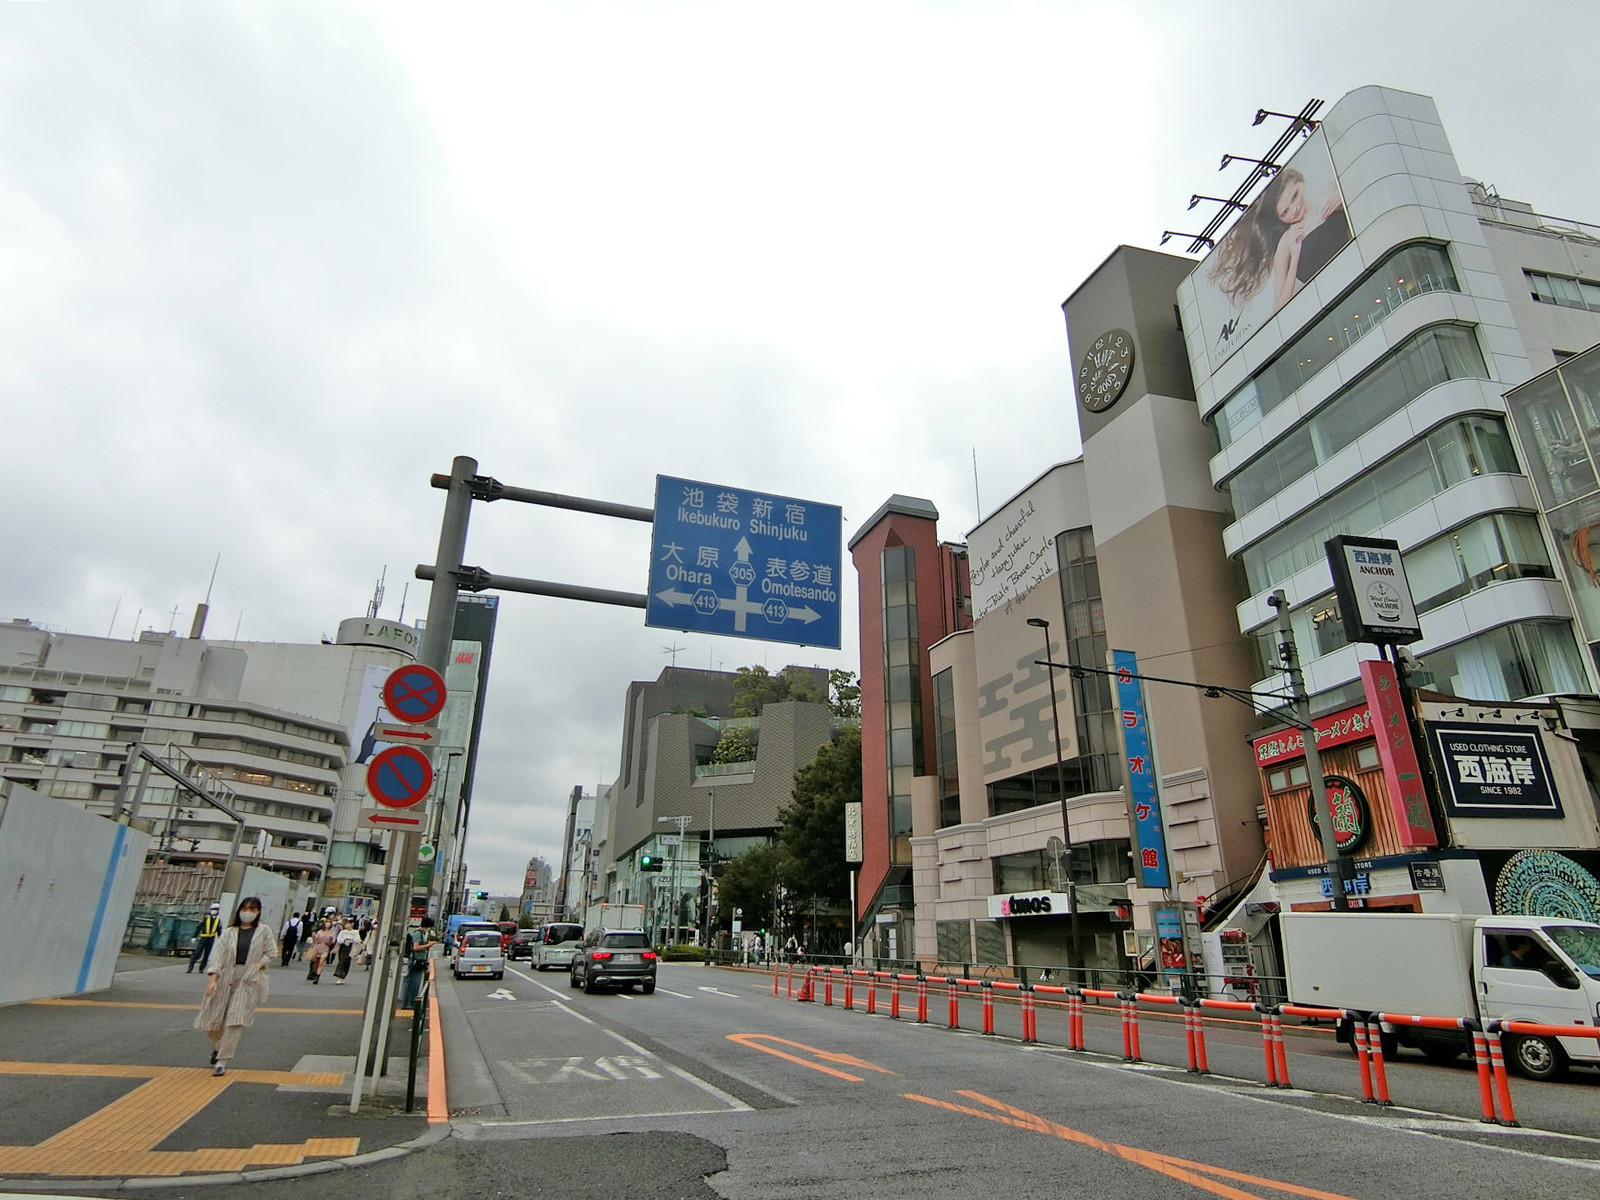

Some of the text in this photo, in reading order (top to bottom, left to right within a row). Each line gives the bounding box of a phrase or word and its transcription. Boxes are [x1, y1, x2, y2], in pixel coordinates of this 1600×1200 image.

[1115, 336, 1123, 347] 2
[1121, 347, 1128, 358] 3
[1120, 364, 1127, 373] 4
[1080, 383, 1087, 392] 9
[1114, 381, 1120, 390] 5
[1085, 393, 1092, 403] 8
[1094, 397, 1100, 407] 7
[1104, 392, 1111, 403] 6
[681, 486, 806, 525] 池袋 新宿
[677, 507, 808, 541] Ikebukuro Shinjuku
[660, 541, 719, 569] 大原
[1029, 537, 1054, 565] Castle
[1352, 550, 1393, 565] 西海岸
[666, 564, 713, 586] Ohara
[732, 566, 753, 582] 305
[765, 557, 833, 586] 表参道
[1360, 566, 1395, 576] ANCHOR
[762, 578, 837, 603] Omotesando
[696, 594, 716, 609] 413
[1373, 602, 1399, 610] ANCHOR
[766, 604, 785, 618] 413
[1378, 674, 1406, 748] ラーメン
[1449, 743, 1528, 754] USED CLOTHING STORE
[1116, 666, 1159, 869] カラオケ館
[1453, 755, 1536, 785] 西海岸
[1480, 786, 1522, 795] SINCE 1982
[1307, 867, 1321, 875] USED
[1001, 895, 1052, 915] atmos
